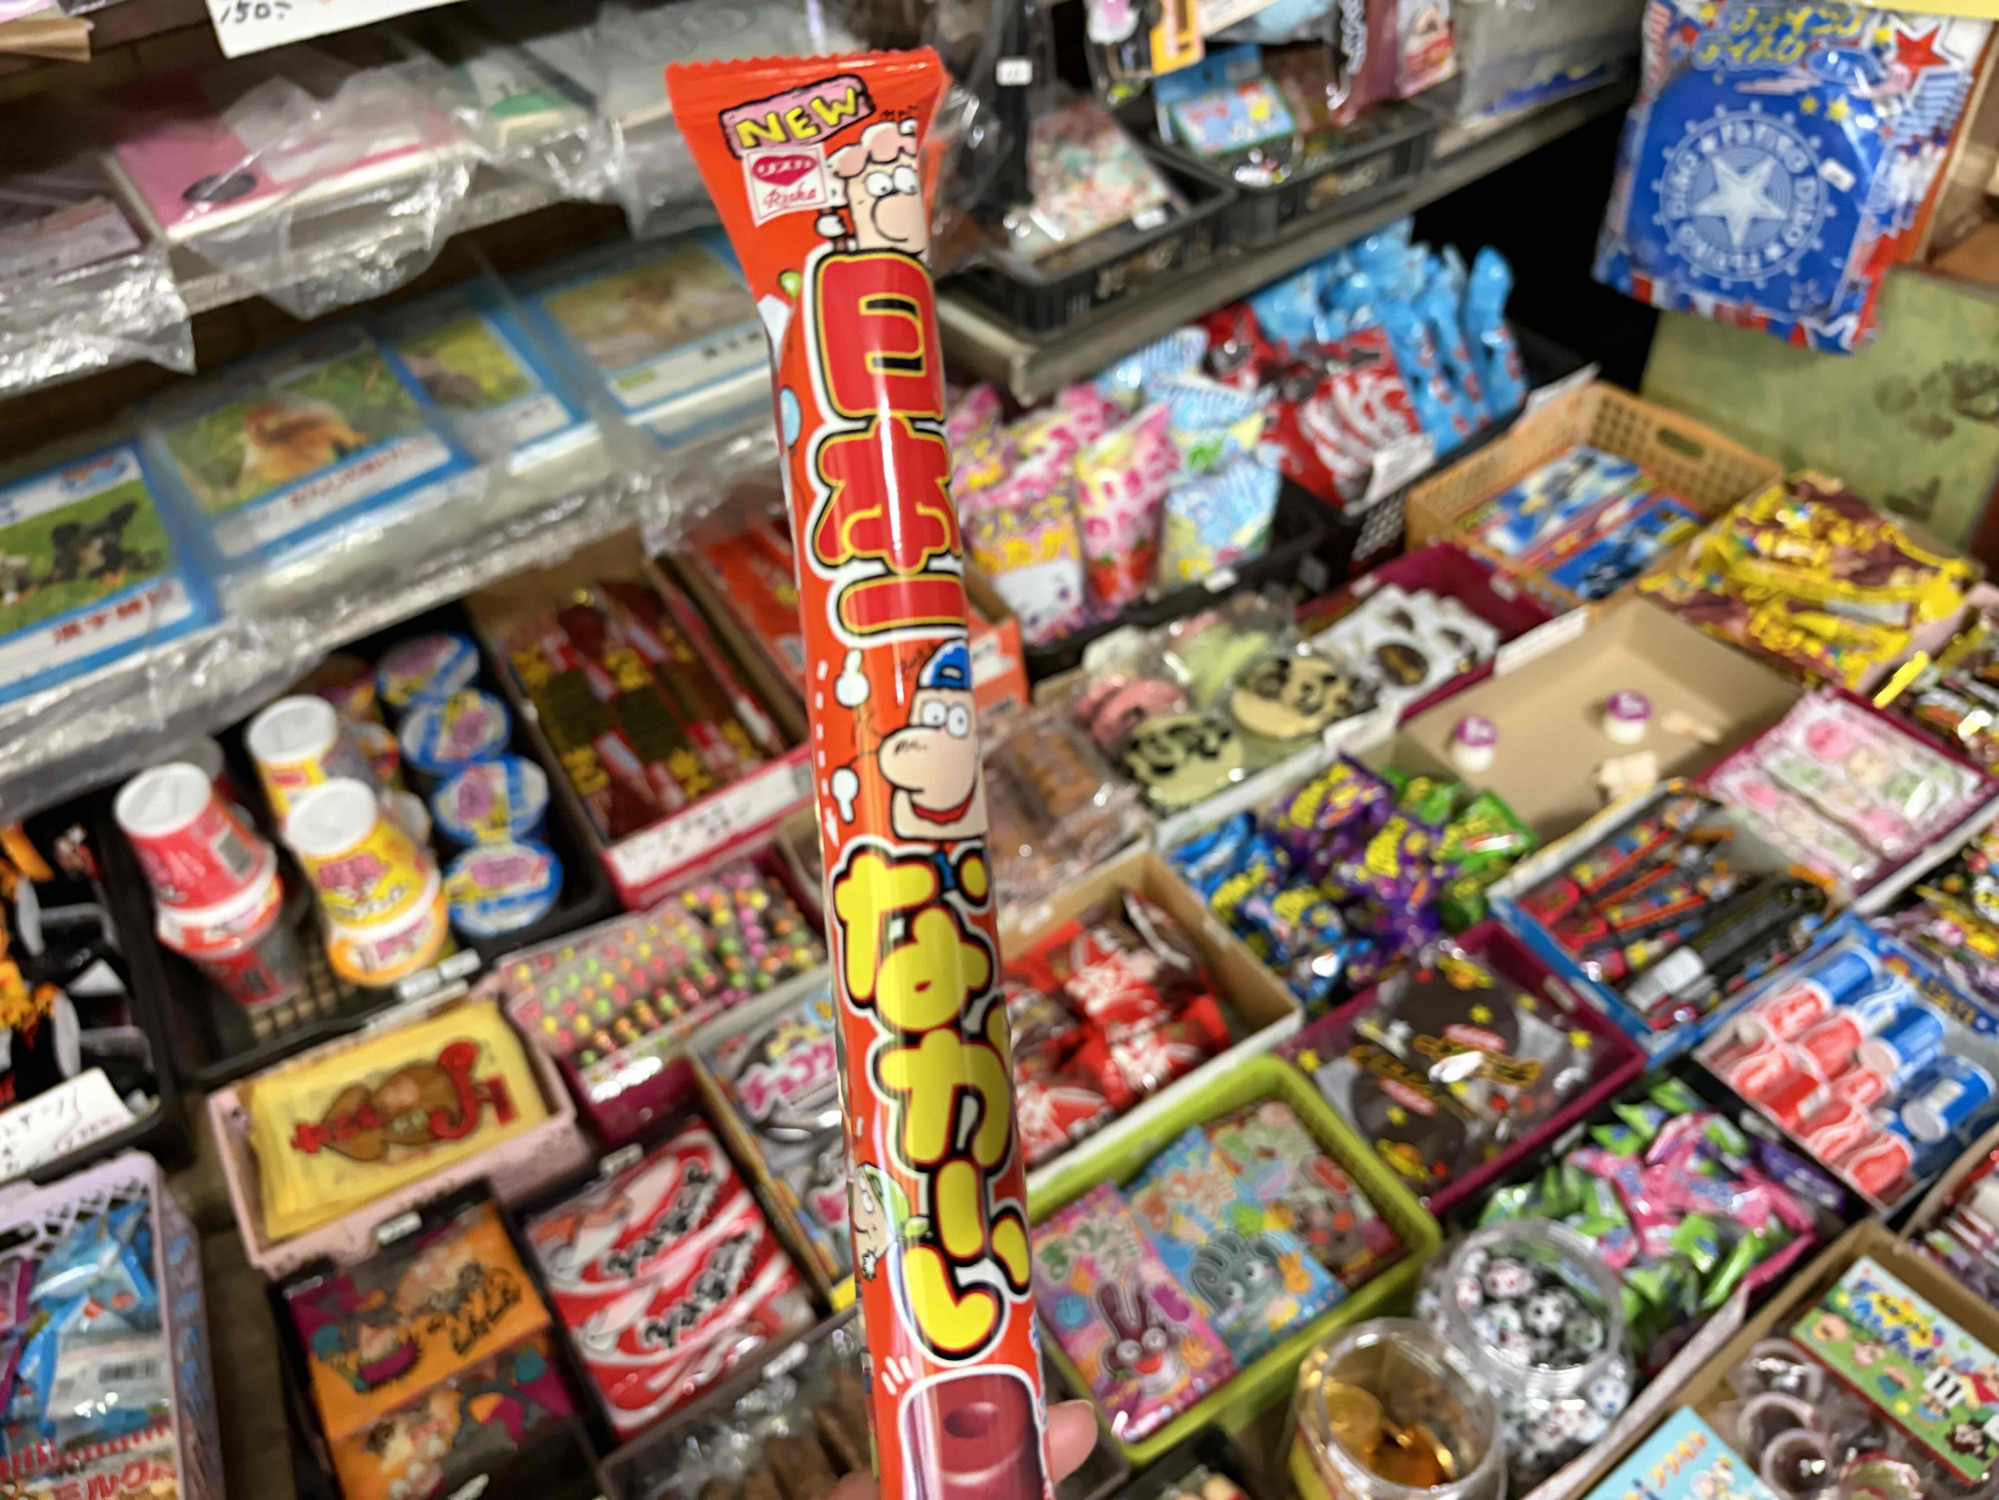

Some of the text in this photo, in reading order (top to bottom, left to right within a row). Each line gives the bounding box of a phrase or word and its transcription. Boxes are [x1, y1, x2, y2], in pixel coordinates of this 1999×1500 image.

[735, 85, 860, 149] NEW
[815, 253, 1031, 1353] 日本一 ながーい
[1933, 1372, 1962, 1401] 11
